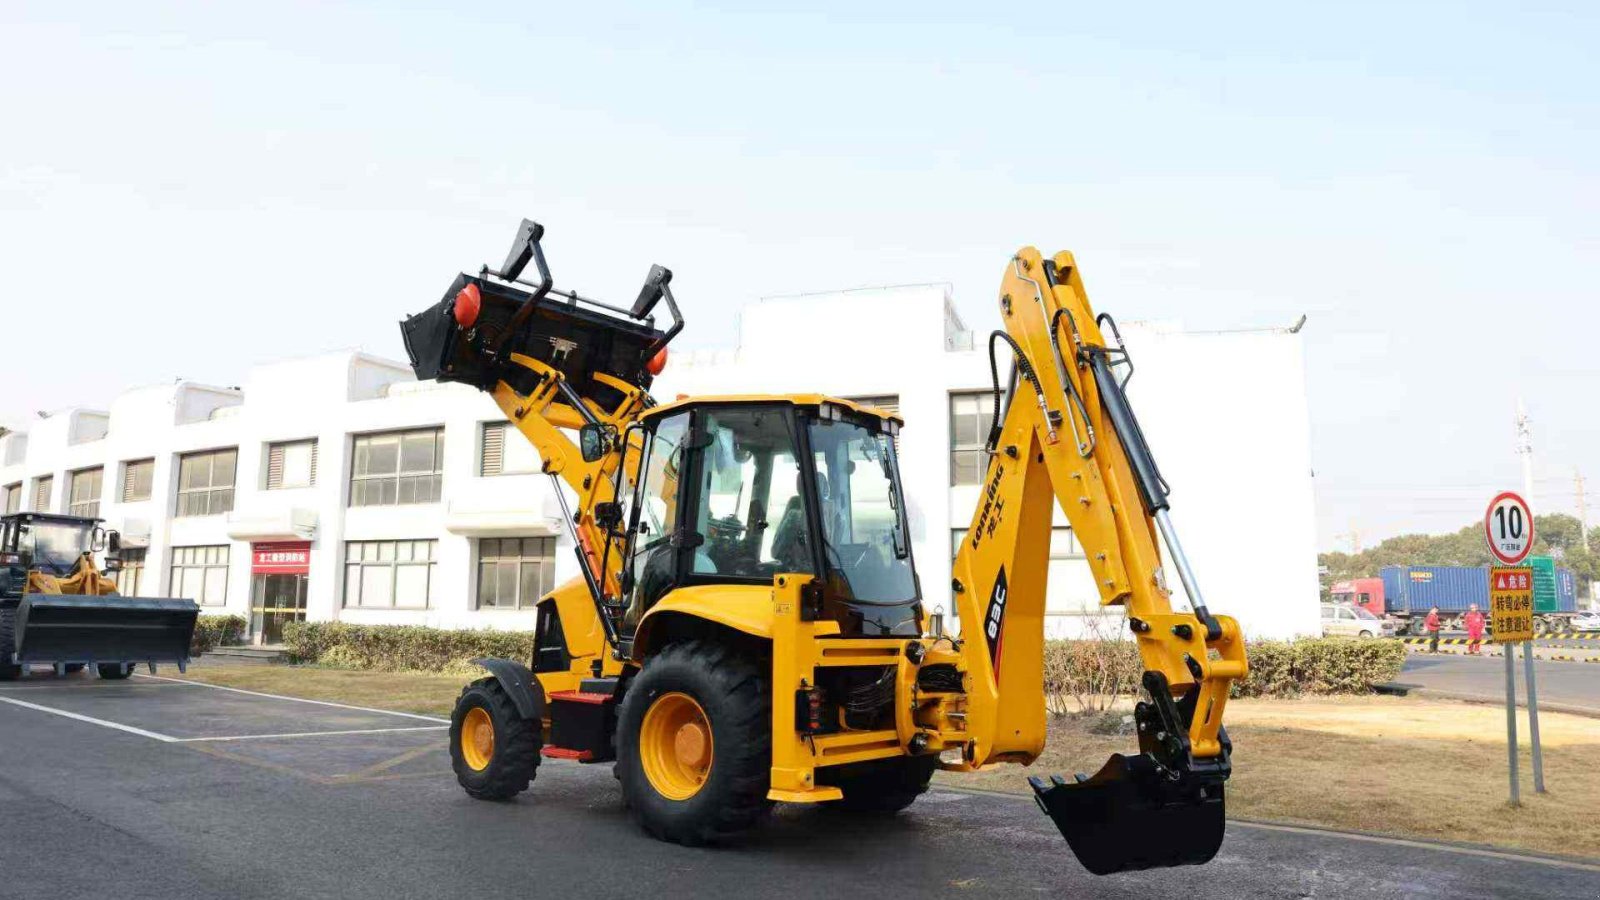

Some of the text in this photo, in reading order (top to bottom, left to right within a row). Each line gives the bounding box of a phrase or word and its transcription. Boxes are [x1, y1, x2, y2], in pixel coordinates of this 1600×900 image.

[987, 494, 1005, 539] 龙工
[1495, 505, 1522, 539] 10
[1509, 574, 1527, 589] 危险
[987, 584, 1006, 639] 83C
[1496, 594, 1530, 611] 转弯必停
